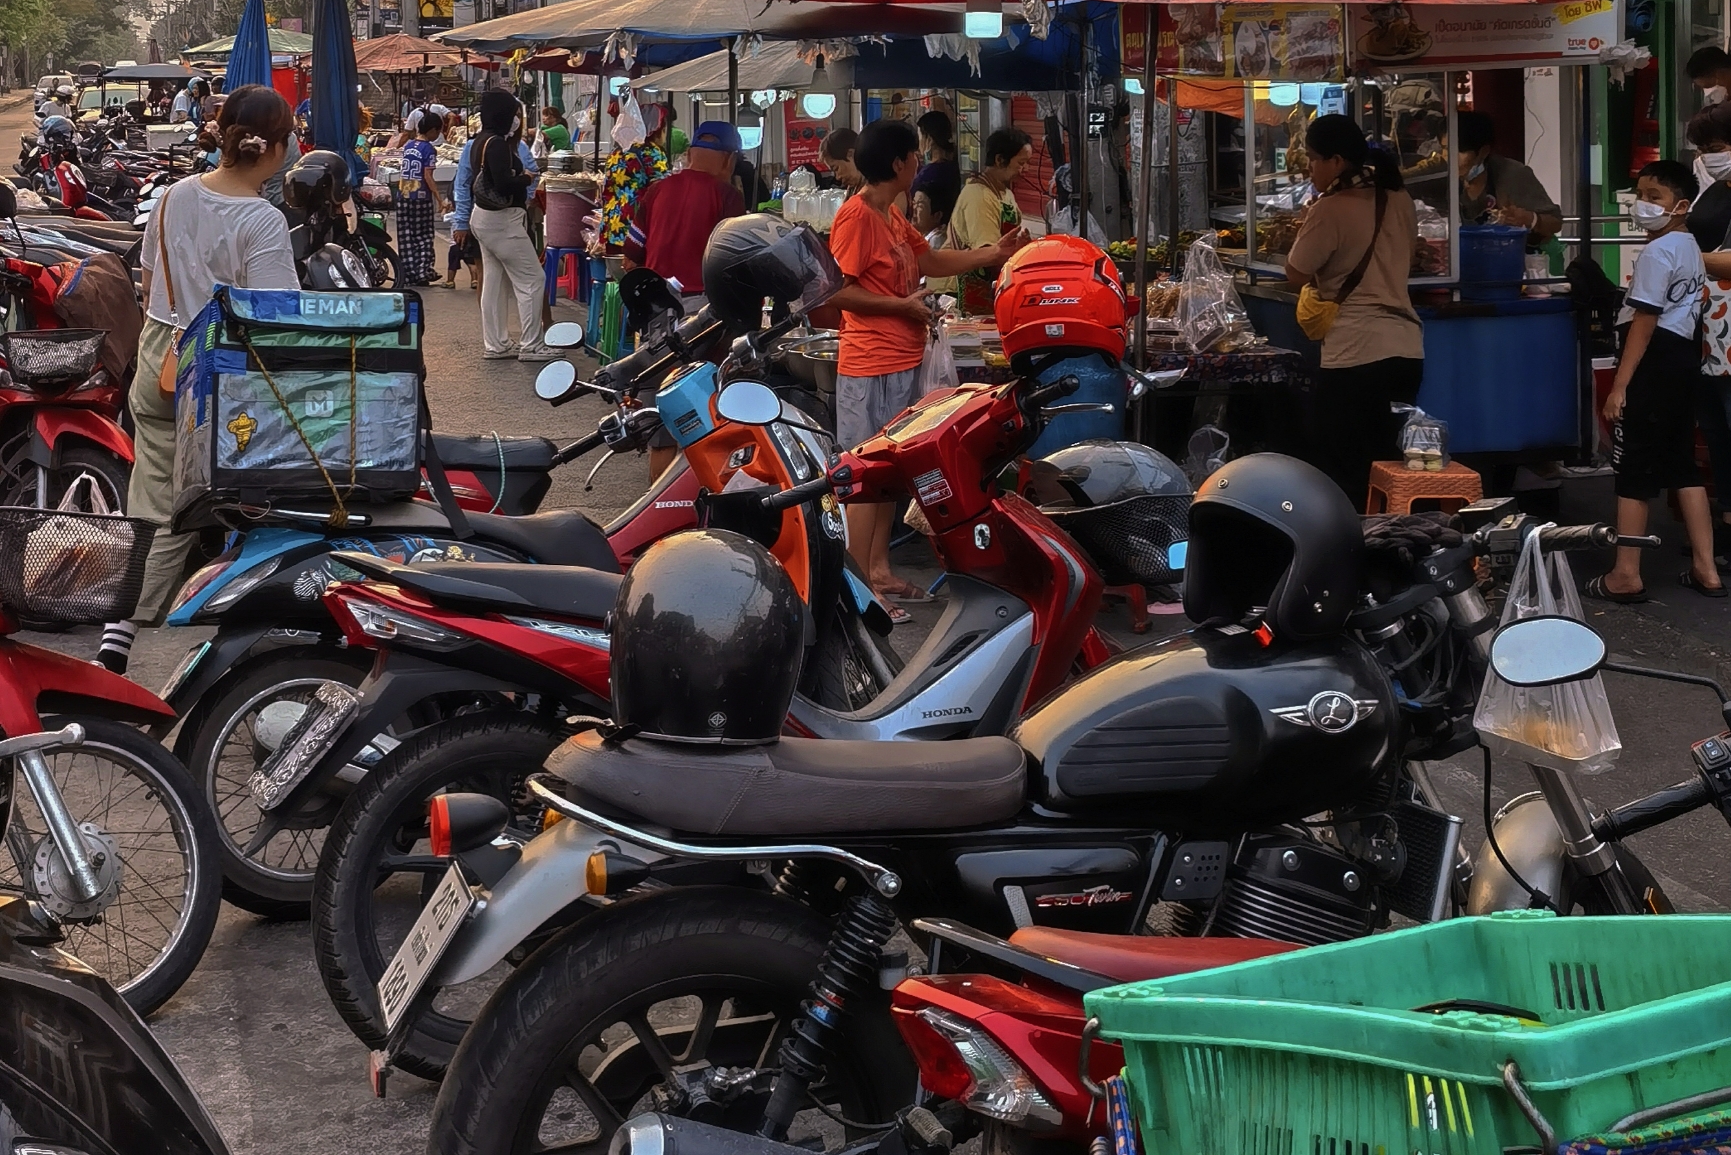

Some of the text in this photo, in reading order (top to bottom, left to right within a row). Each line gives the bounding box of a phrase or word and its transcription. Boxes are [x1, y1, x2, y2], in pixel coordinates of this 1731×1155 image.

[1567, 37, 1587, 47] true
[400, 158, 422, 180] 22
[655, 499, 695, 509] HOND
[921, 706, 973, 719] HONDA
